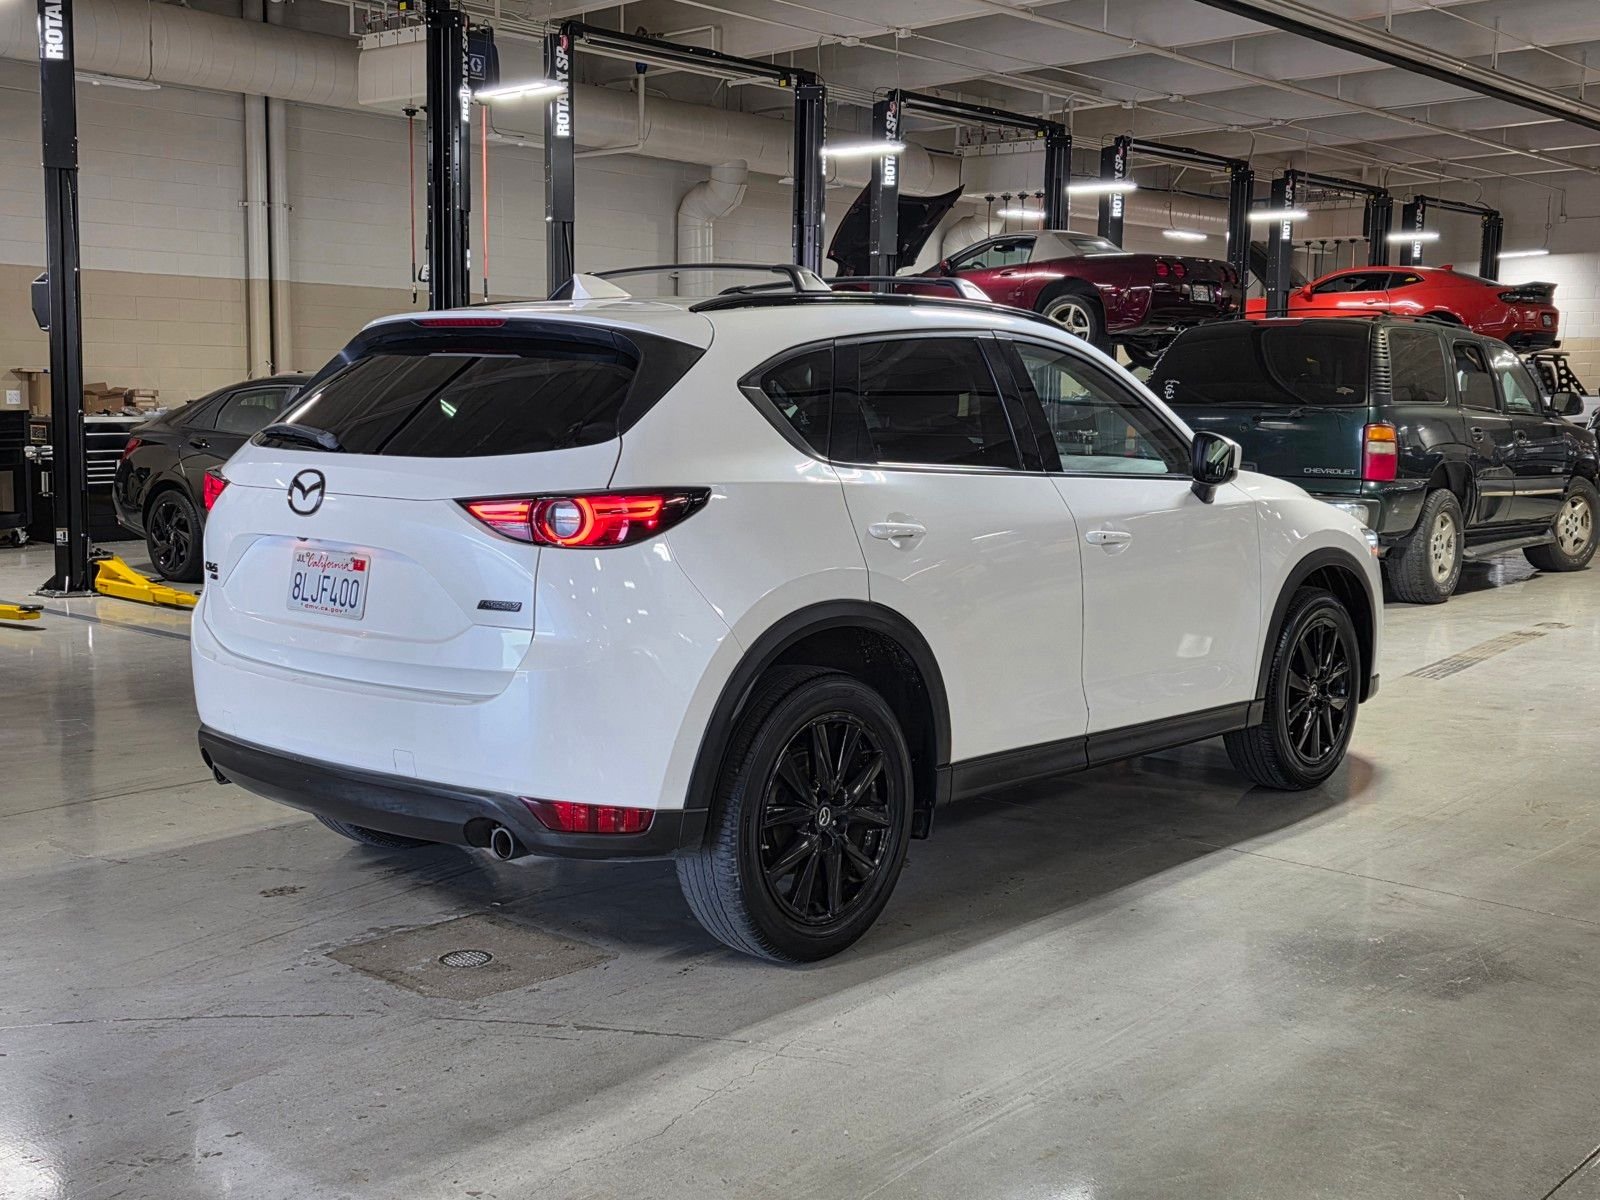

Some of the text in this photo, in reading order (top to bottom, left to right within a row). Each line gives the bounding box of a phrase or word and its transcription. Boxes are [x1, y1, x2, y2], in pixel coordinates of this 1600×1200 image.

[45, 0, 63, 59] ROTA
[884, 131, 897, 186] ROTY
[1113, 171, 1123, 217] ROTY
[1282, 200, 1292, 240] ROTY
[1303, 467, 1356, 475] CHEVROLET
[306, 551, 350, 573] California
[292, 572, 360, 609] 8LJF400
[304, 603, 343, 614] dmv.ca.gov
